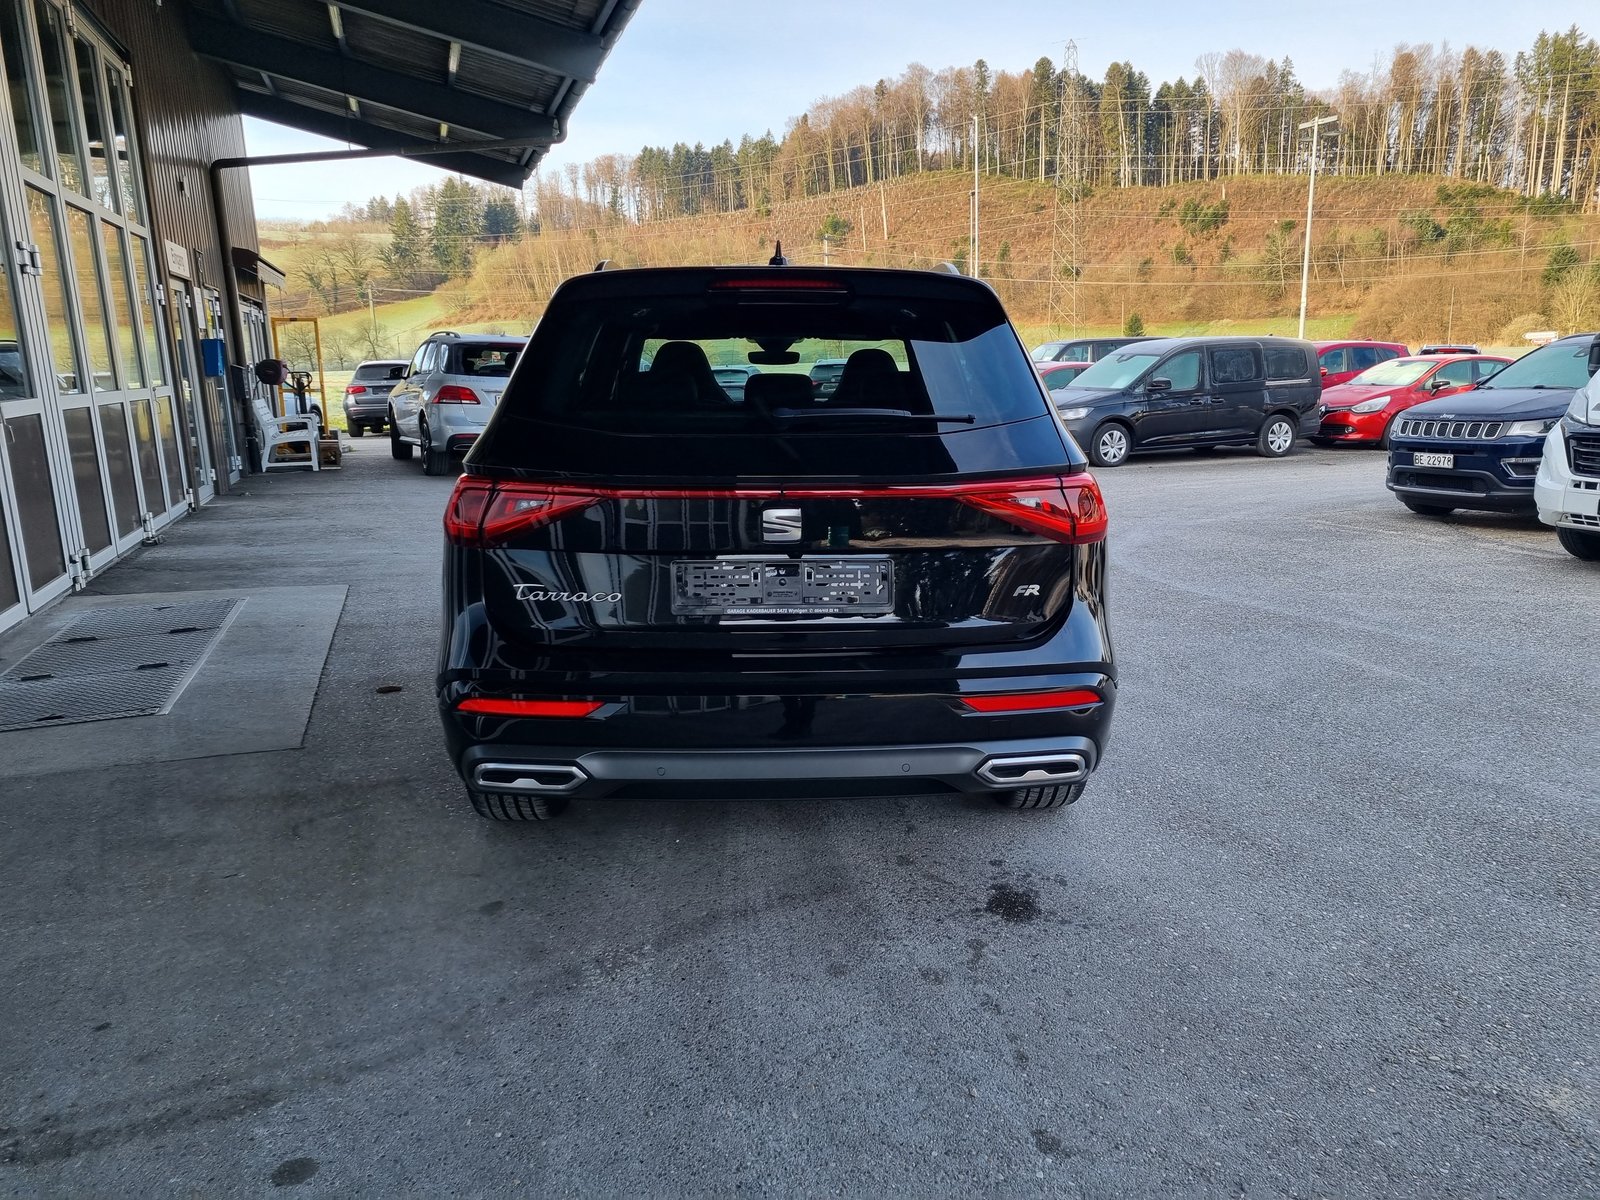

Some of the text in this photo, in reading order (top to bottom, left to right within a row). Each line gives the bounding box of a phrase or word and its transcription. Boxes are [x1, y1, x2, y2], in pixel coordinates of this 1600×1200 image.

[1414, 454, 1452, 466] BE 22978
[513, 583, 622, 602] Tarraco
[1012, 584, 1041, 597] FR
